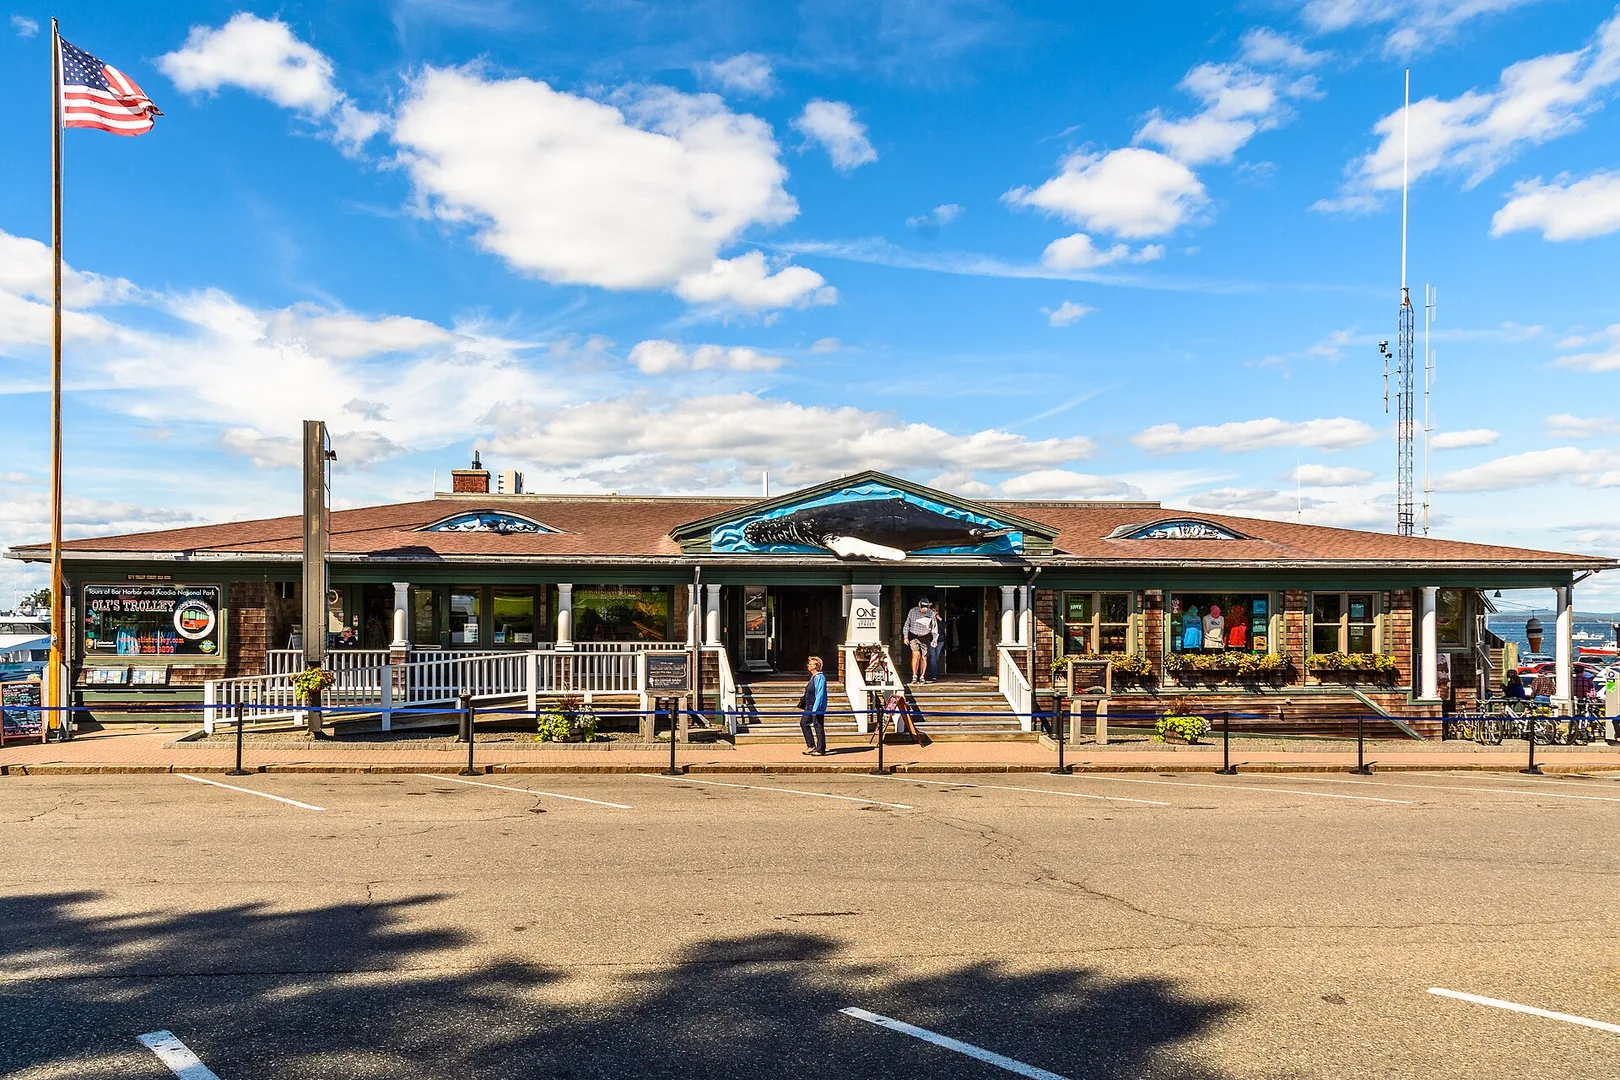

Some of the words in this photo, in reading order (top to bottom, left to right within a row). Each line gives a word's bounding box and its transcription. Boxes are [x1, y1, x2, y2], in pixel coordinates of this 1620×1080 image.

[143, 588, 155, 596] and
[155, 588, 176, 596] Acadia
[92, 599, 121, 612] OLI'S
[122, 599, 175, 612] TROLLEY
[856, 607, 877, 618] ONE
